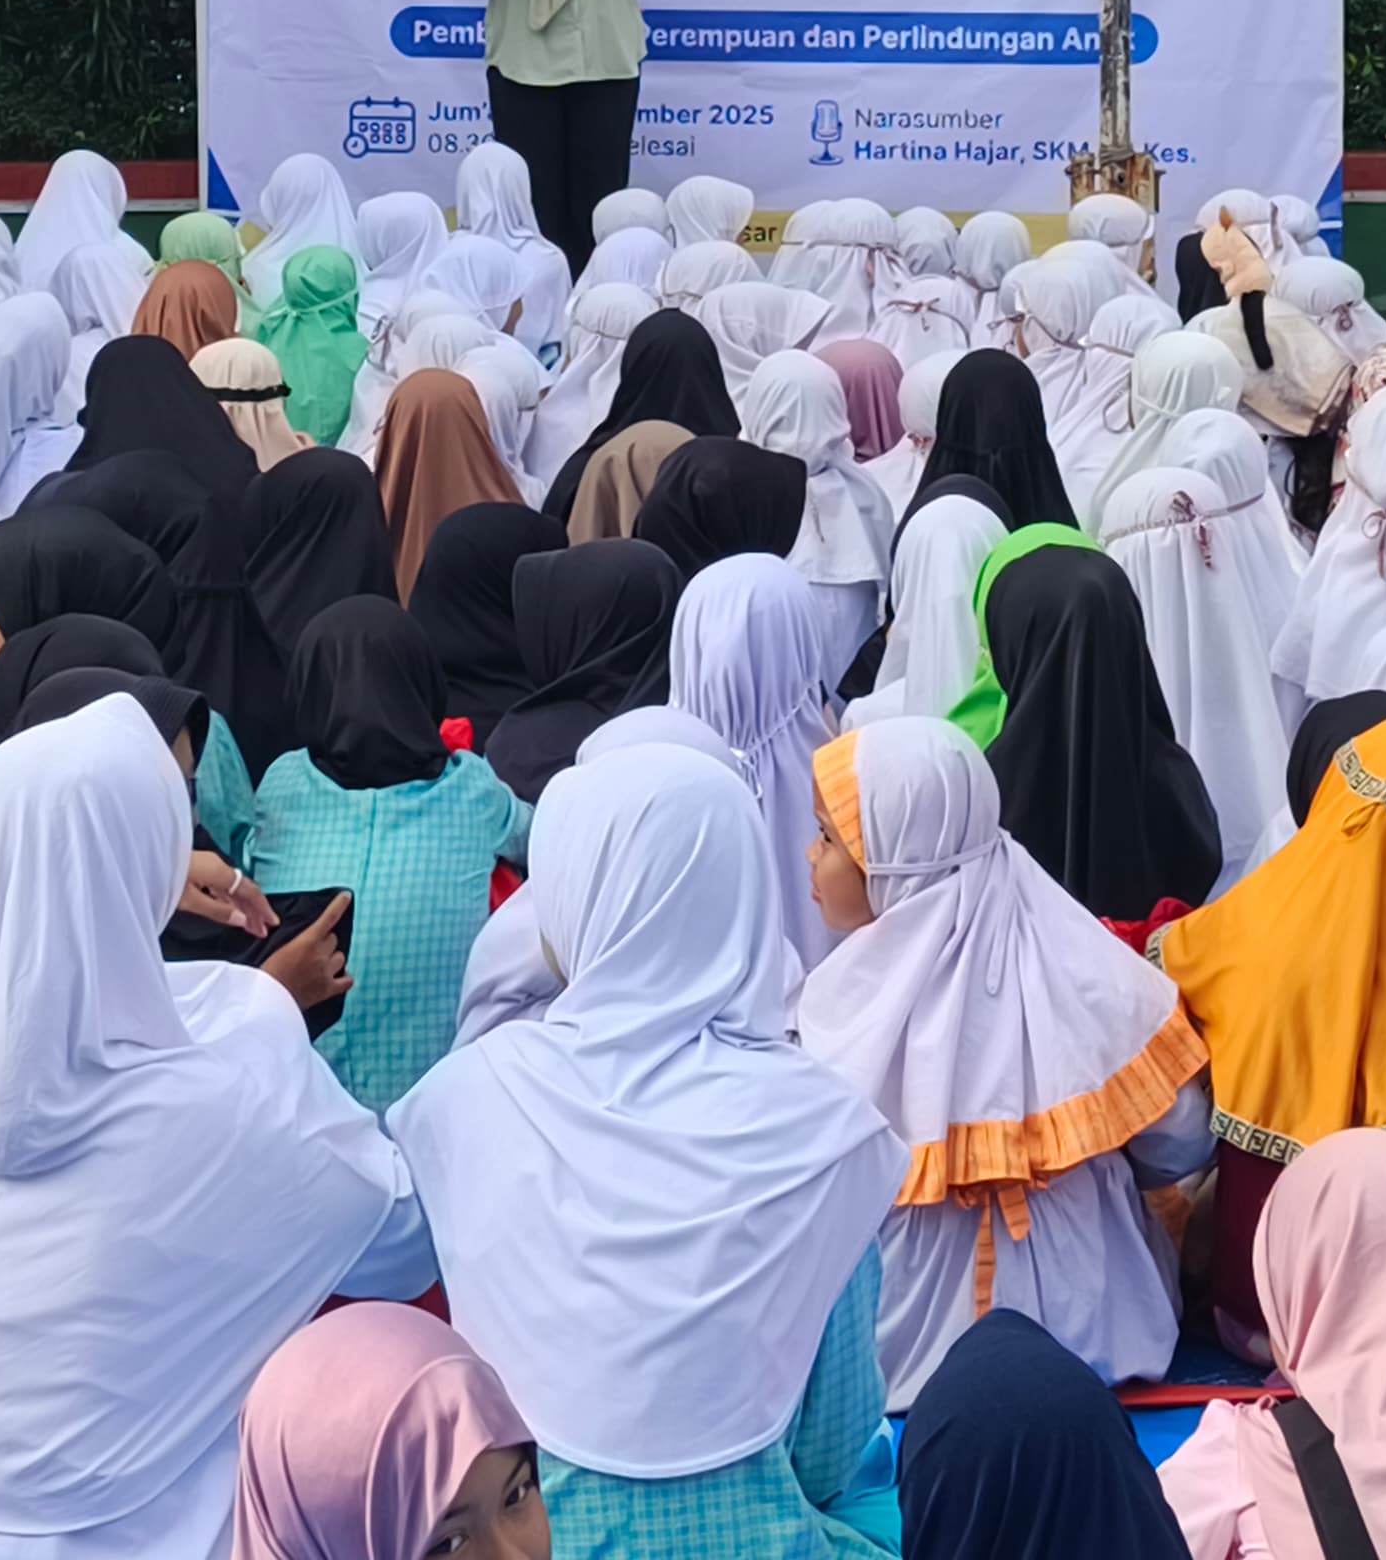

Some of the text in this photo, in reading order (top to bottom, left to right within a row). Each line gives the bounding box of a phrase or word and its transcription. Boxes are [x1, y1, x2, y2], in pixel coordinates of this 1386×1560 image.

[803, 24, 855, 49] dan
[863, 24, 1054, 56] Perlindungan
[709, 104, 775, 125] 2025
[854, 108, 1004, 130] Narasumber
[629, 134, 696, 157] elesai
[854, 140, 948, 161] Hartina
[954, 140, 1025, 166] Hajar,
